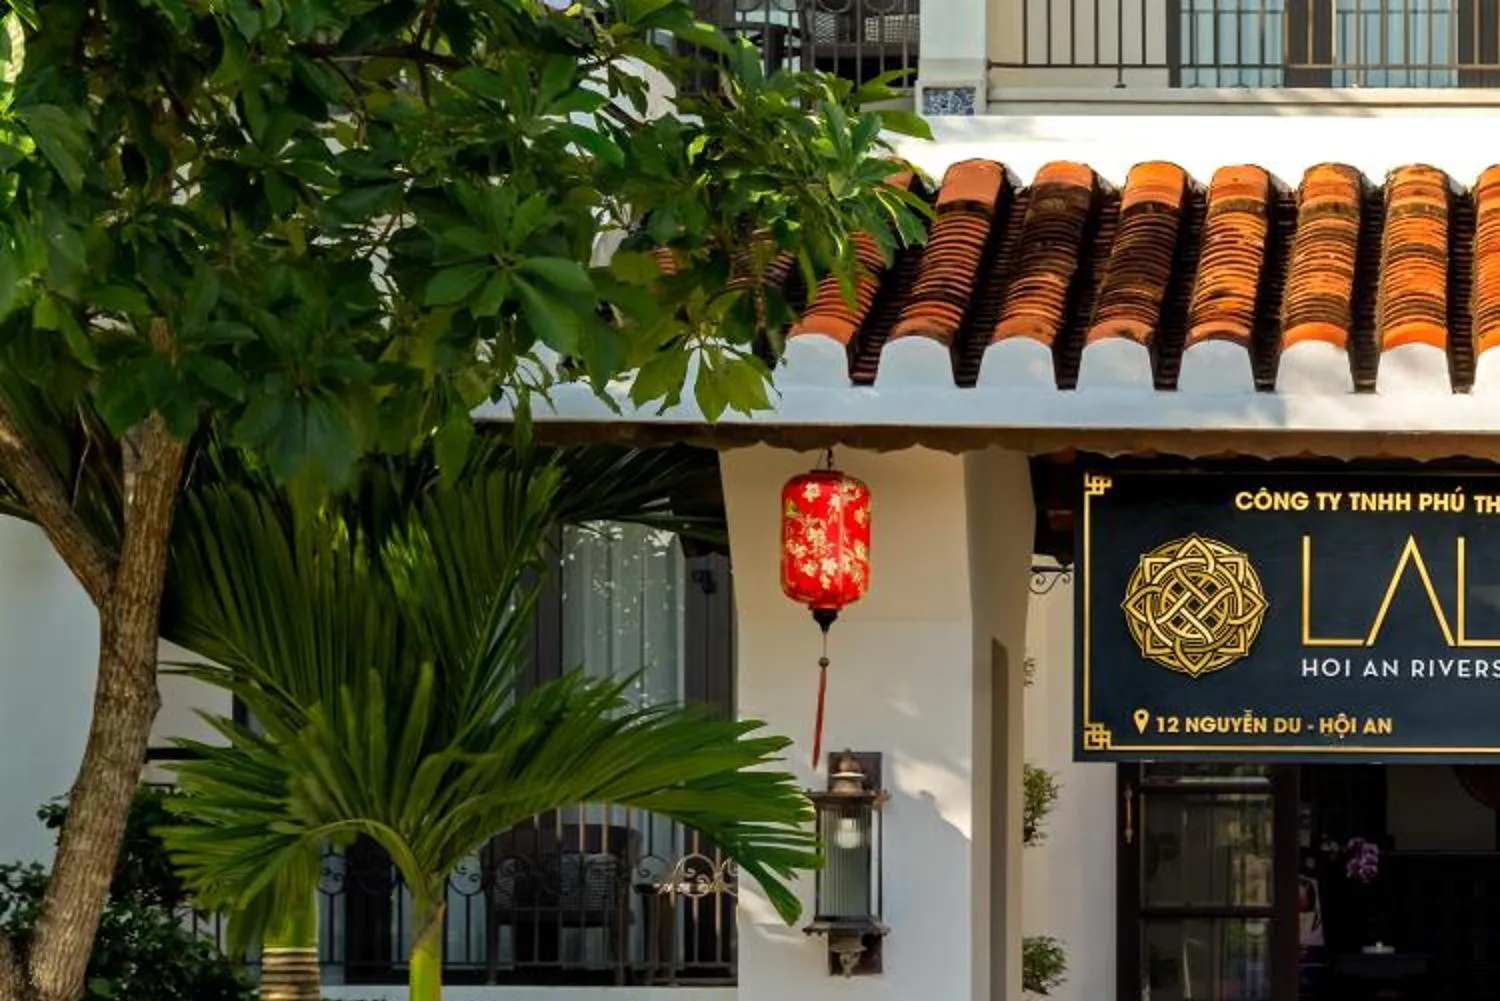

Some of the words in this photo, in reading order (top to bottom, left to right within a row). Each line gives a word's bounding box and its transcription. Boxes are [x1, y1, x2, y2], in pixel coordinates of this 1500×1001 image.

[1235, 487, 1309, 511] CÔNG
[1316, 492, 1342, 511] TY
[1349, 493, 1411, 511] TNHH
[1419, 486, 1465, 513] PHÚ
[1302, 659, 1351, 677] HOI
[1363, 660, 1398, 677] AN
[1156, 716, 1179, 733] 12
[1273, 717, 1301, 734] DU
[1319, 712, 1356, 739] HỘI
[1363, 718, 1392, 734] AN
